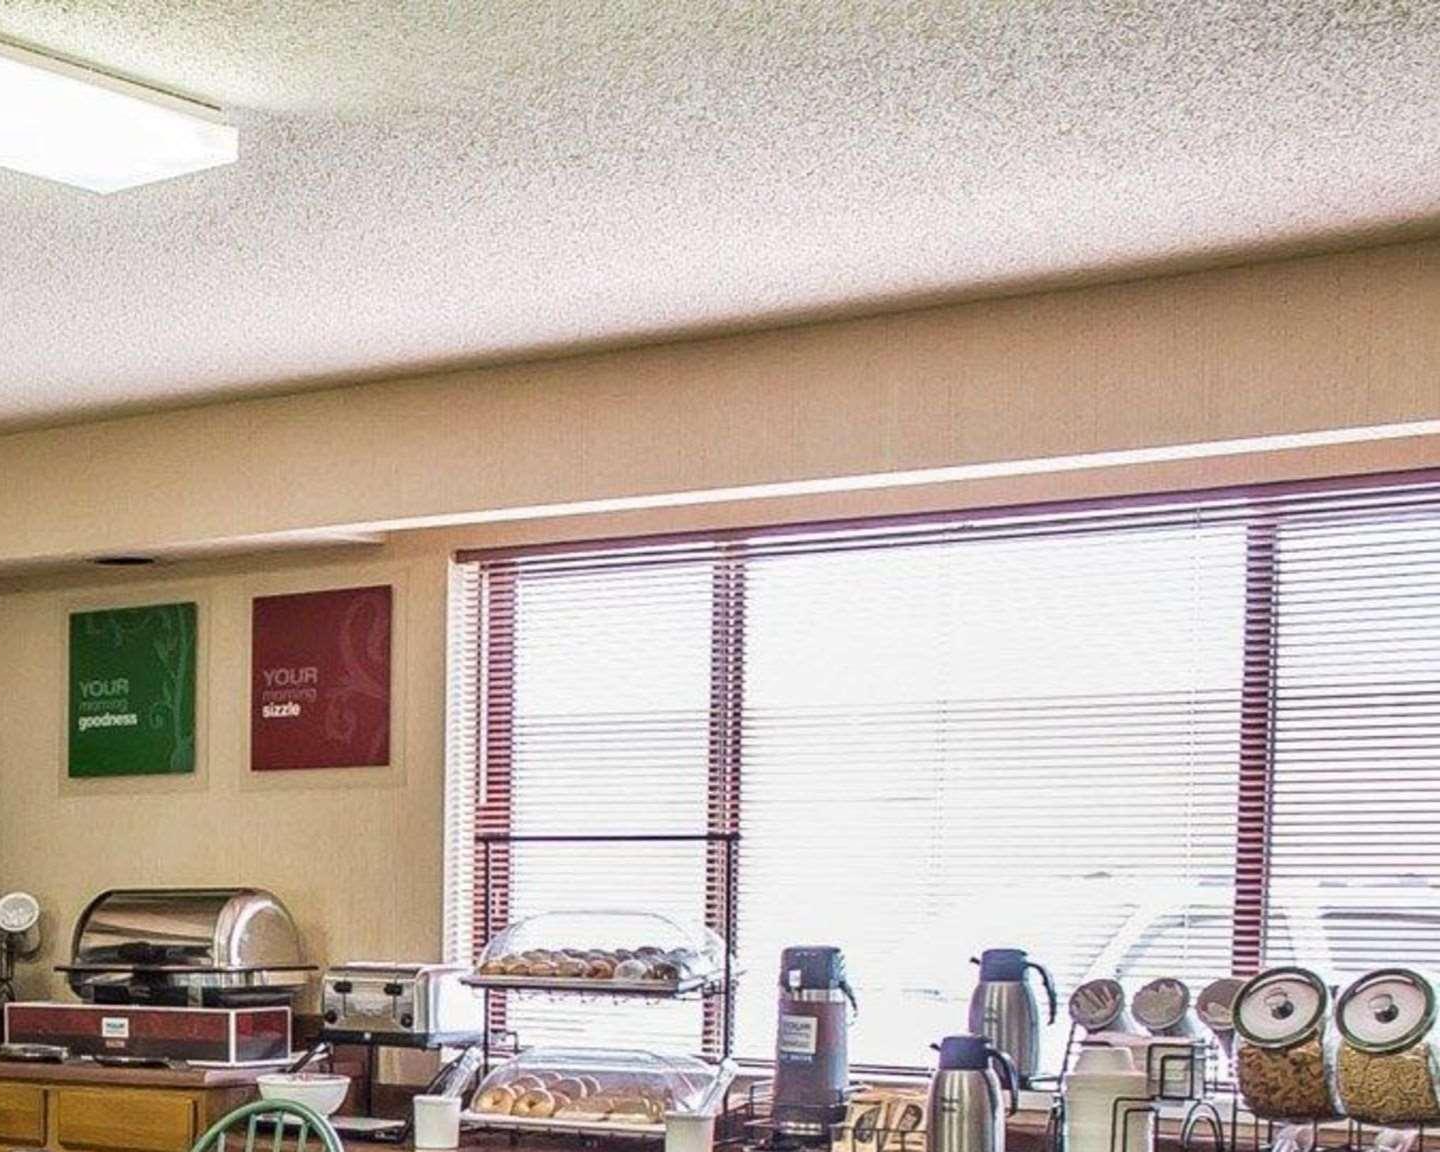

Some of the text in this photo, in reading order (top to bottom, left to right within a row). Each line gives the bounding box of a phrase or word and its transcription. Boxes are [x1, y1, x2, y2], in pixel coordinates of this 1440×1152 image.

[263, 666, 318, 686] YOUR
[79, 678, 129, 698] YOUR
[262, 701, 301, 718] sizzle
[78, 711, 138, 732] goodness
